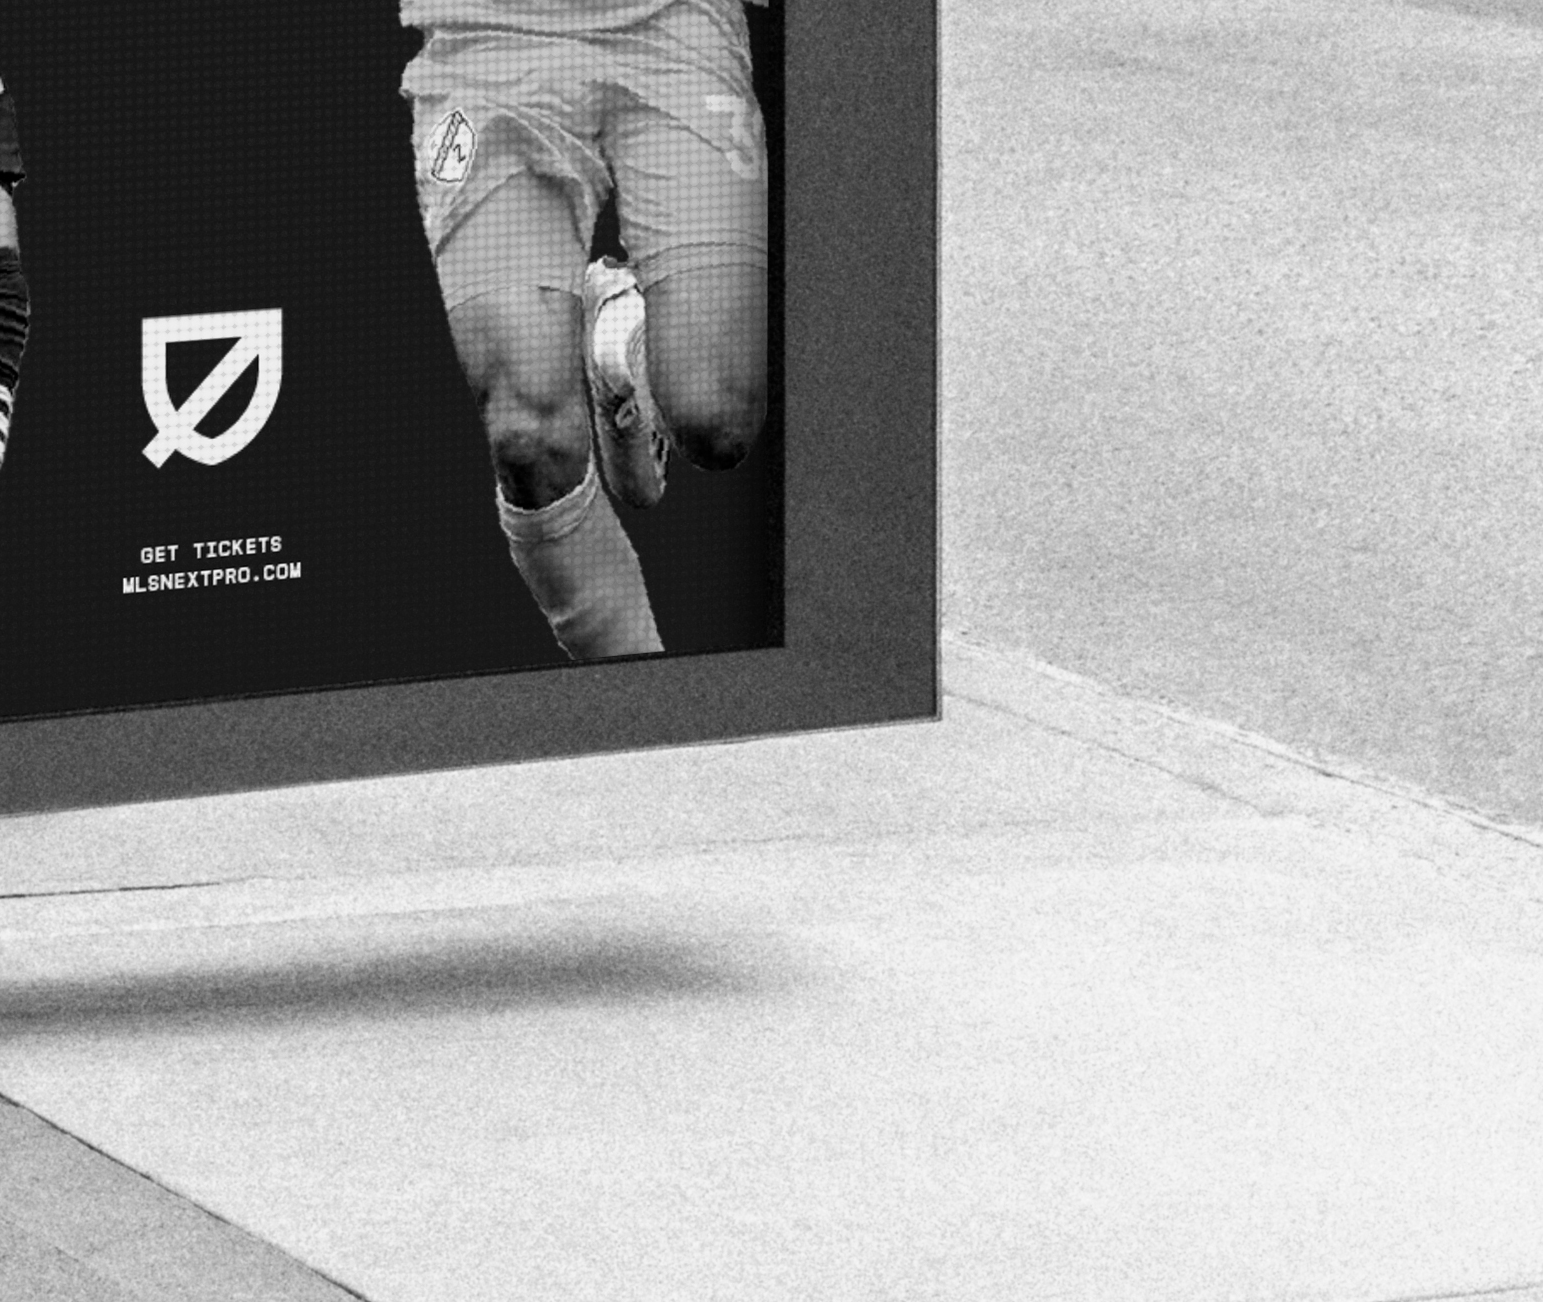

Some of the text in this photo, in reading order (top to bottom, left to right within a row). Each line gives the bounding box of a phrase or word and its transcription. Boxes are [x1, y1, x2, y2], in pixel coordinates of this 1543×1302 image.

[141, 536, 281, 563] GET TICKETS
[123, 560, 301, 593] MLSNEXTPRO.COM
